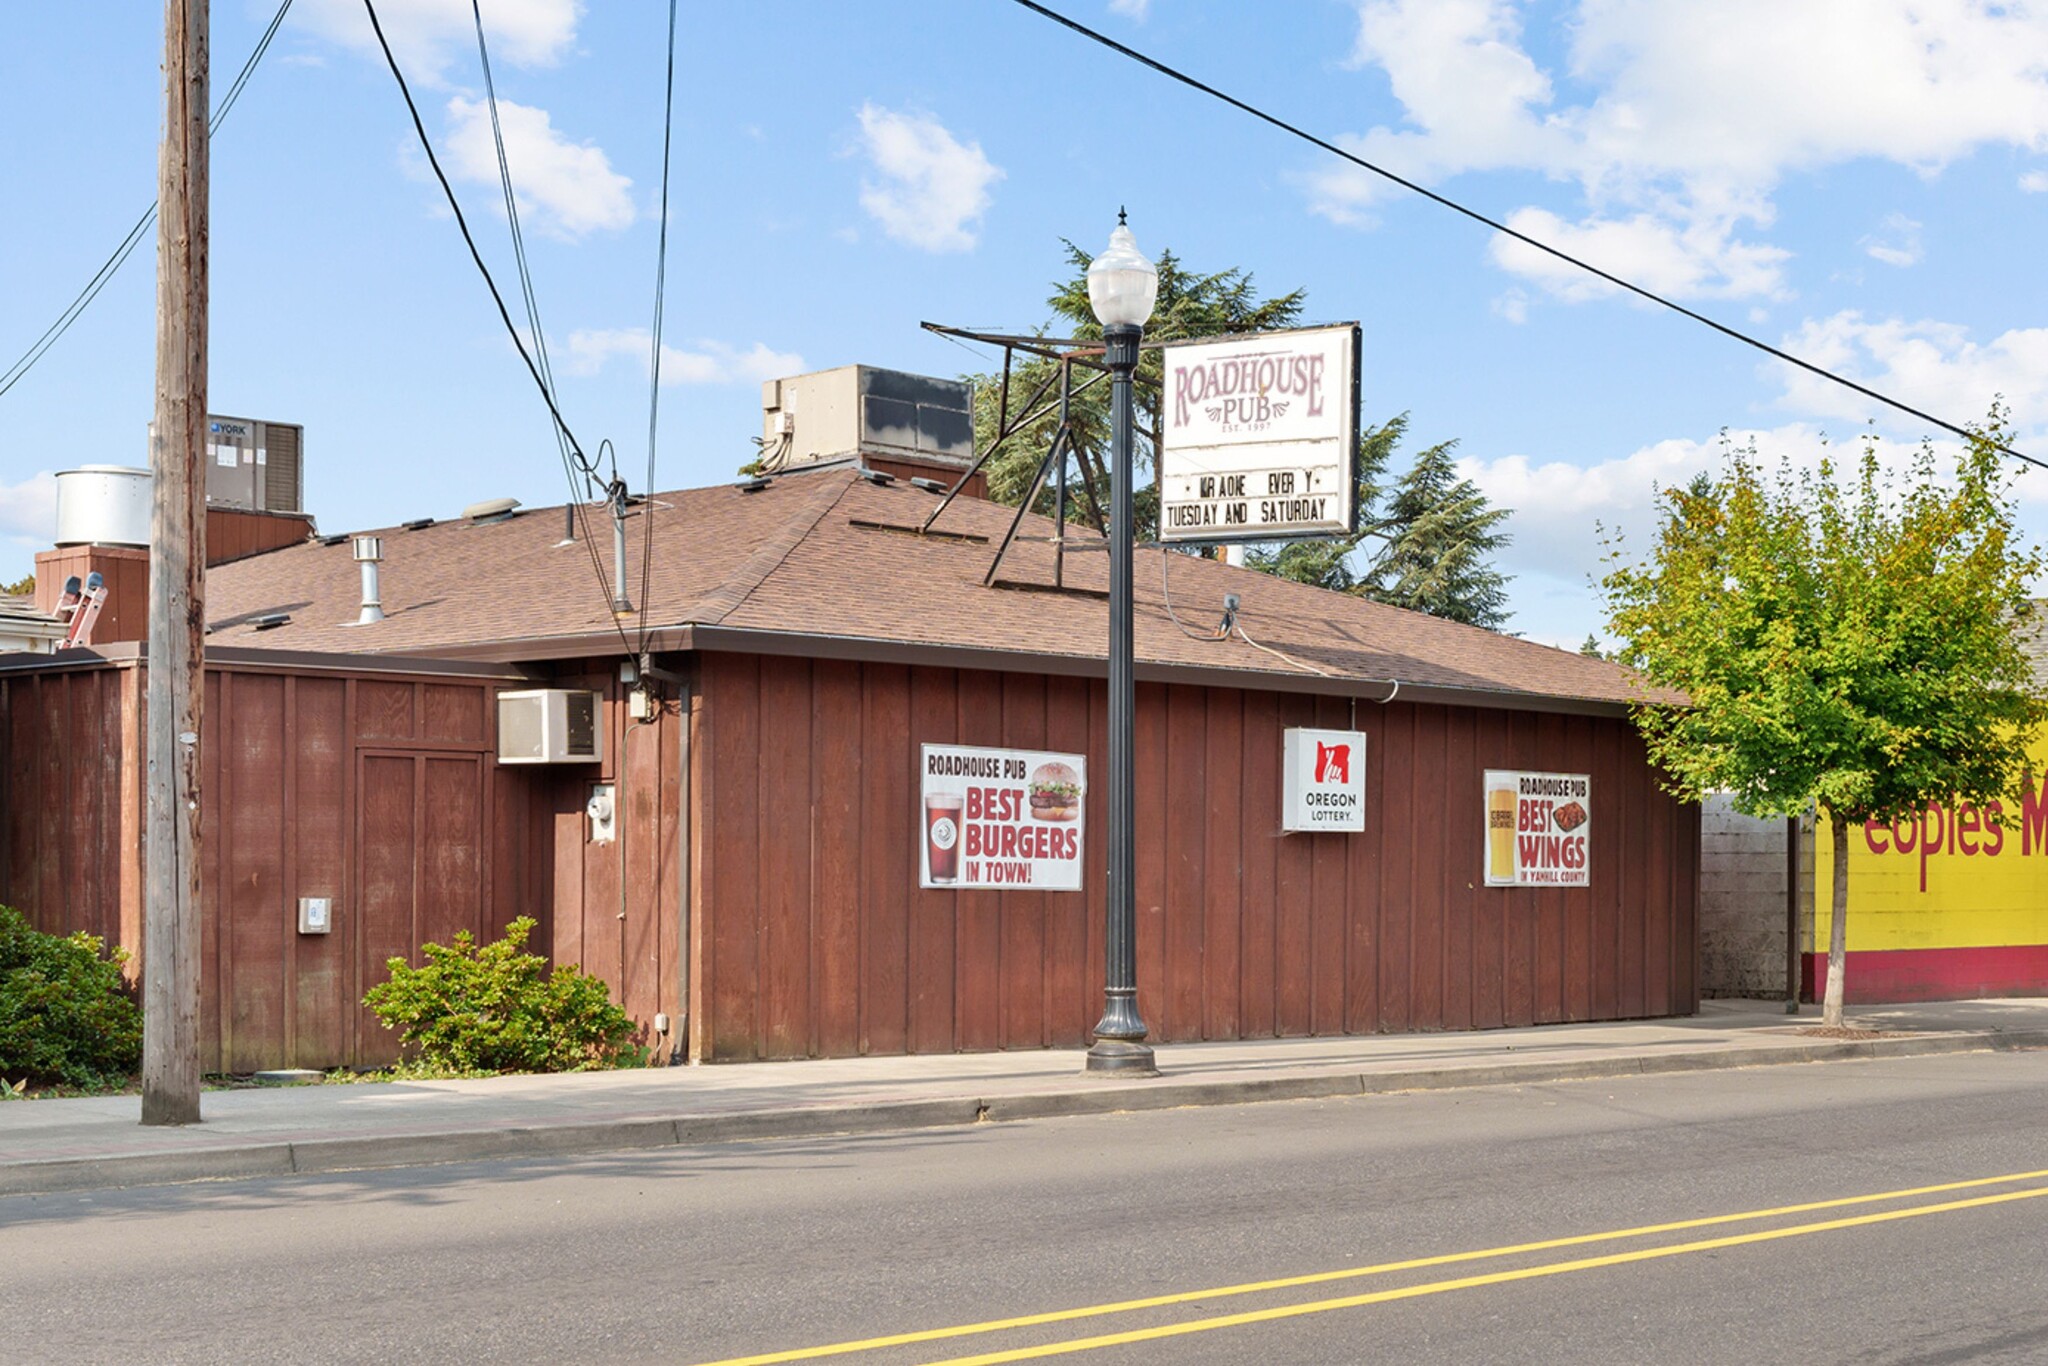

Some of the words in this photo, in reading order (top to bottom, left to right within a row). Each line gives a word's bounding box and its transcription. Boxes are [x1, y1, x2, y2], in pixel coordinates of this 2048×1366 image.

[1174, 352, 1325, 428] ROADHOUSE
[1223, 397, 1271, 424] PUB
[221, 424, 246, 435] YORK
[1248, 422, 1271, 432] 1997
[1168, 503, 1217, 527] TUESDAY
[1225, 502, 1248, 525] AND
[1261, 498, 1326, 523] SATURDAY
[928, 755, 999, 778] ROADHOUSE
[1004, 759, 1026, 779] PUB
[1306, 792, 1356, 806] OREGON
[1520, 778, 1569, 796] ROADHOUSE
[1571, 780, 1586, 797] PUB
[966, 786, 1024, 821] BEST
[1518, 799, 1553, 832] BEST
[965, 824, 1077, 860] BURGERS
[1518, 835, 1585, 869] WINGS
[1863, 789, 2004, 892] eoples
[966, 861, 979, 882] IN
[986, 862, 1032, 883] TOWN!
[1521, 871, 1527, 882] IN
[1560, 871, 1585, 882] COUNTY
